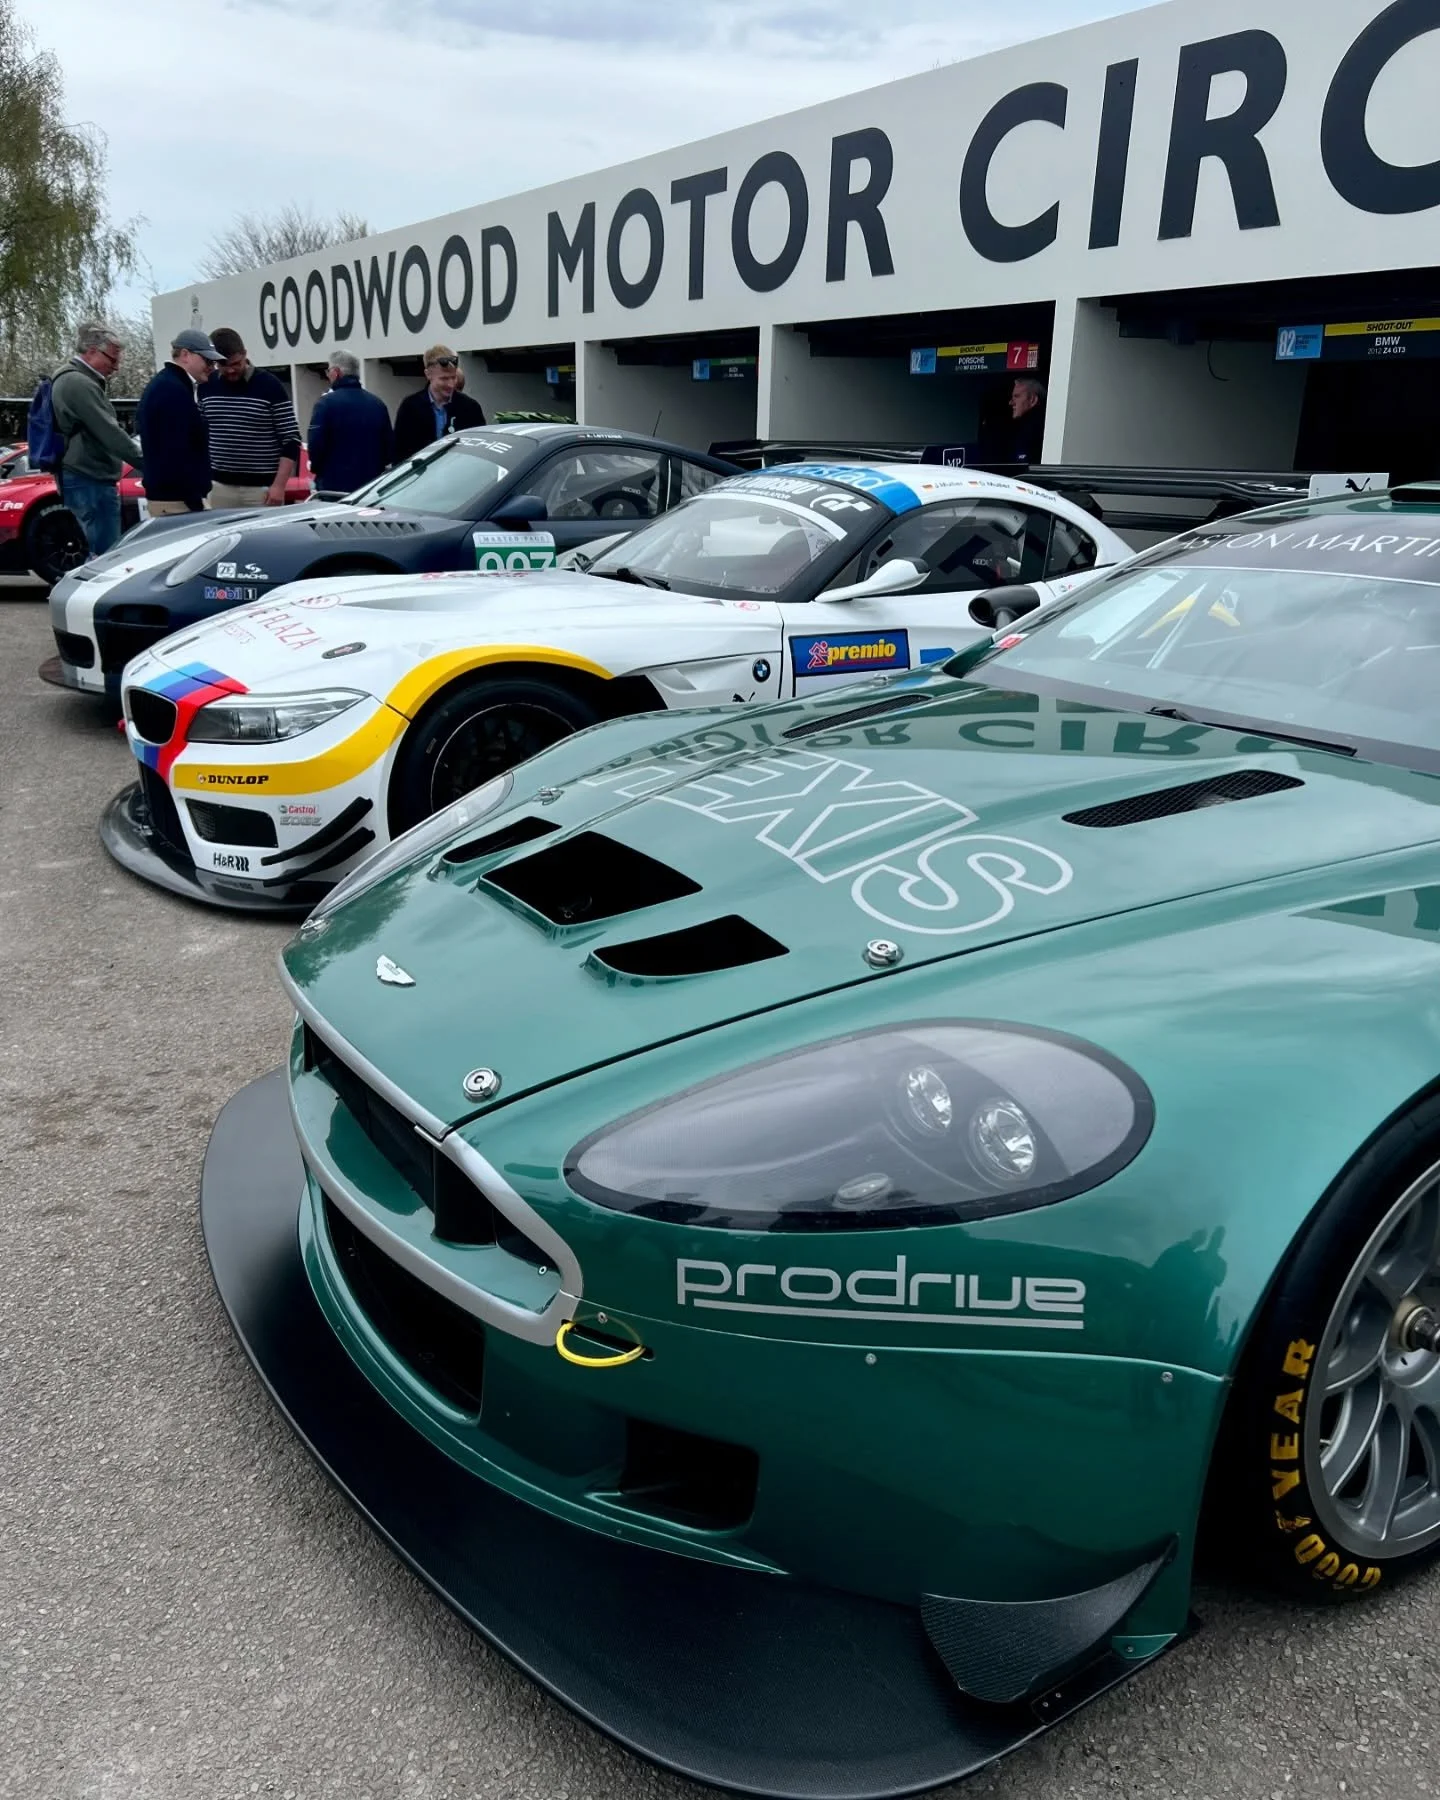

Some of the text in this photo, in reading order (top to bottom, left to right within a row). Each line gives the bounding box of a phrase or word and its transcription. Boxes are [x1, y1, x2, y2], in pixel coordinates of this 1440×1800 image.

[260, 226, 518, 350] GOODWOOD
[548, 127, 895, 317] MOTOR
[1366, 321, 1413, 332] SHOOT-OUT
[1375, 336, 1401, 346] BMW
[958, 356, 985, 365] PORSCHE
[1013, 347, 1022, 364] 7
[438, 437, 513, 454] SCHE
[1177, 532, 1295, 550] ASTON
[205, 587, 242, 599] Mobil
[827, 640, 896, 665] premio
[208, 775, 269, 785] DUNLOP
[288, 805, 316, 814] Castrol
[213, 853, 235, 869] H&R
[677, 1255, 1086, 1314] prodrive
